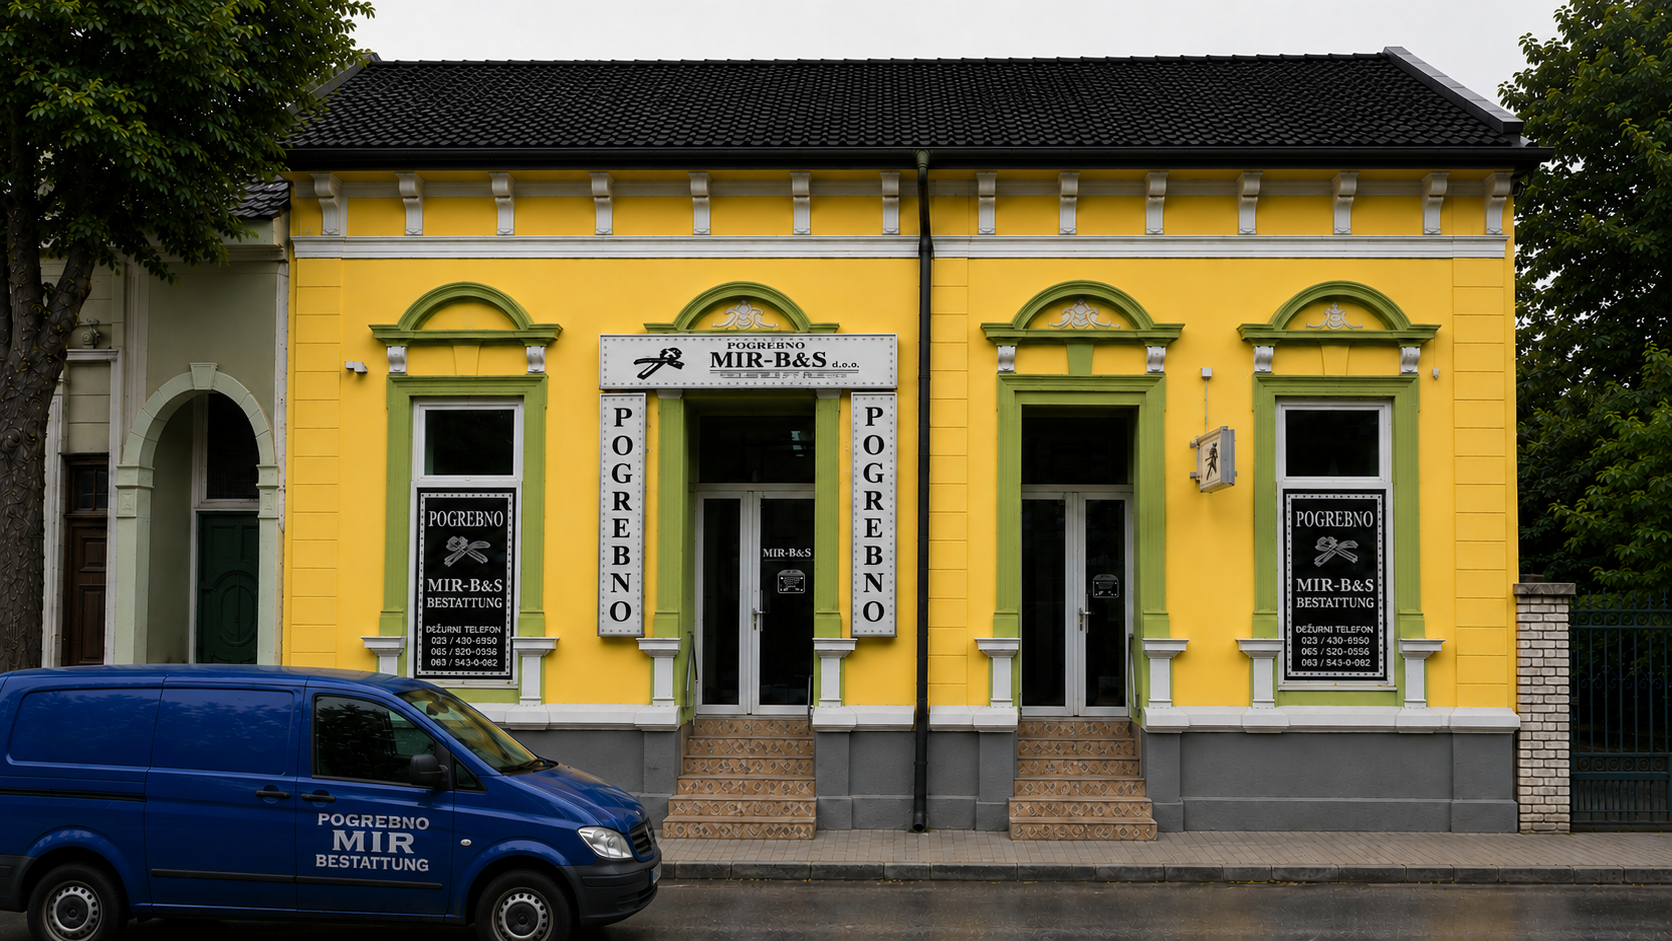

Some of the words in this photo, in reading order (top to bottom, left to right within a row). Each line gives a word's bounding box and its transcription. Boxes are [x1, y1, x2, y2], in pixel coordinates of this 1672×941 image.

[727, 342, 805, 350] POGREBNO
[709, 351, 827, 368] MIR-B&S
[428, 510, 504, 527] POGREBNO
[609, 407, 634, 622] POGREBNO
[863, 406, 885, 623] POGREBNO
[1295, 510, 1374, 528] POGREBNO
[763, 548, 811, 558] MIR-B&S
[427, 578, 503, 593] MIR-B&S
[1296, 578, 1374, 592] MIR-B&S
[426, 597, 503, 608] BESTATTUNG
[1296, 597, 1375, 608] BESTATTUNG
[464, 626, 502, 634] TELEFON
[1335, 626, 1374, 634] TELEFON
[431, 637, 447, 645] 023
[449, 637, 455, 645] /
[1301, 637, 1318, 645] 023
[1320, 637, 1325, 645] /
[448, 648, 454, 656] /
[1320, 648, 1325, 656] /
[448, 659, 453, 667] /
[1319, 659, 1325, 668] /
[317, 813, 430, 830] POGREBNO
[332, 829, 415, 854] MIR
[315, 854, 430, 872] BESTATTUNG
